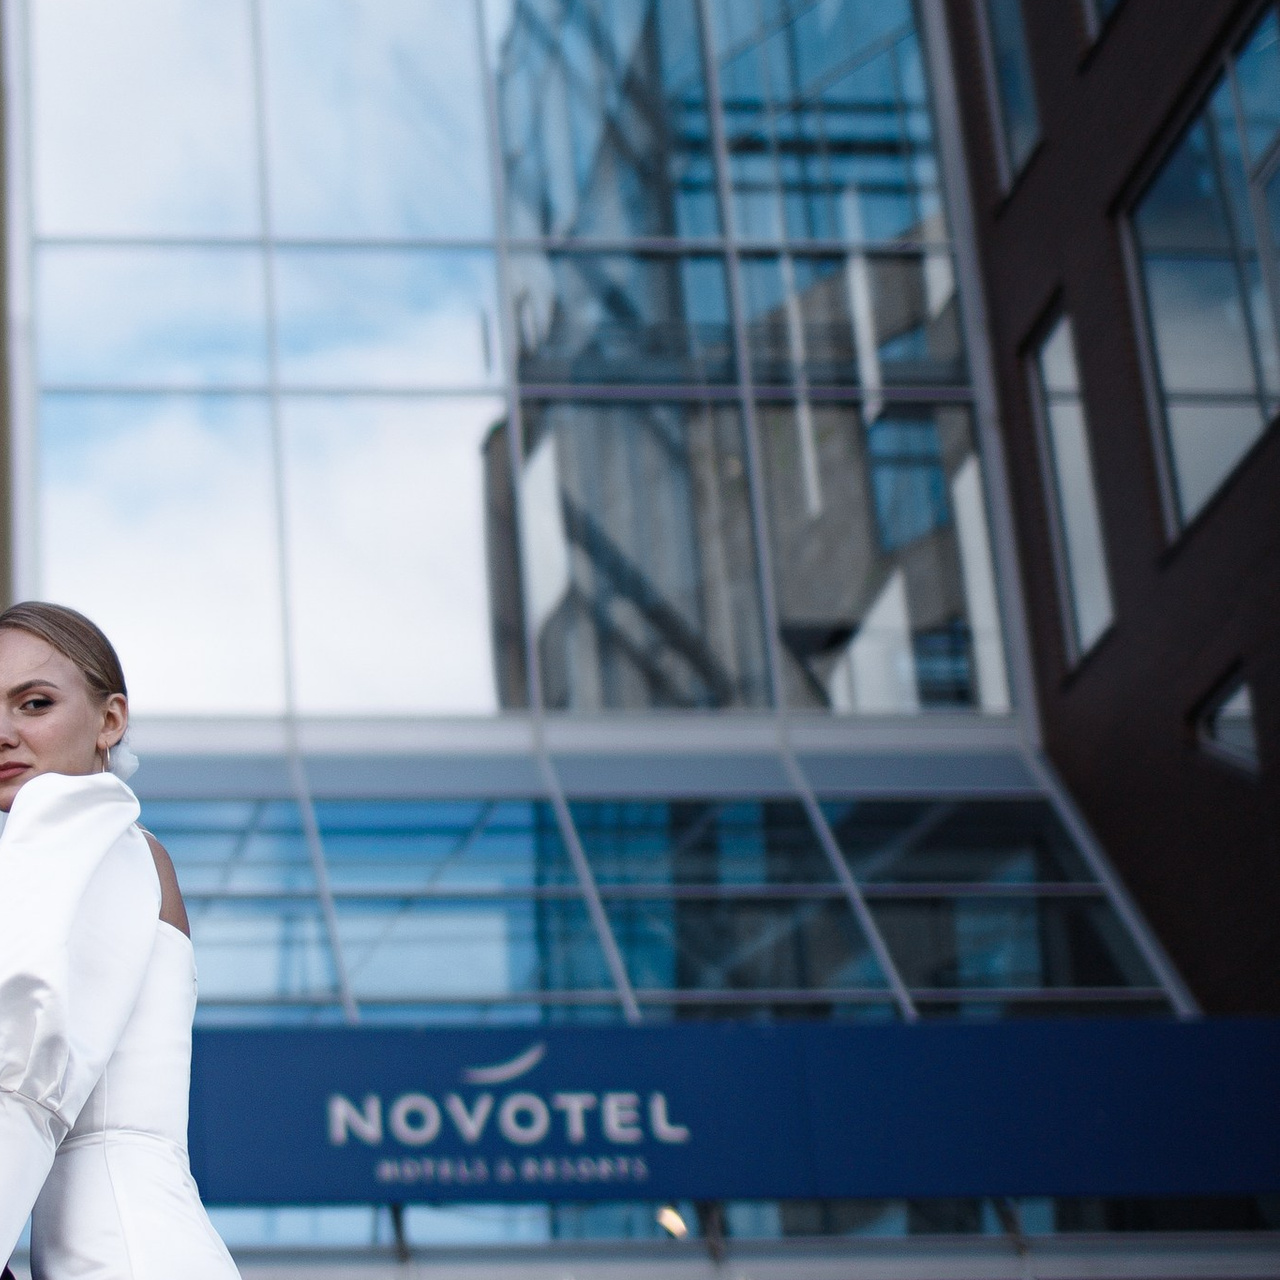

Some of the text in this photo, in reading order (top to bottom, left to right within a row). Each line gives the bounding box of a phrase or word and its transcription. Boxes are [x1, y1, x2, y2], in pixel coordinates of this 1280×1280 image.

[328, 1091, 690, 1146] NOVOTEL
[376, 1156, 489, 1183] HOTELS
[521, 1155, 649, 1183] RESORTS
